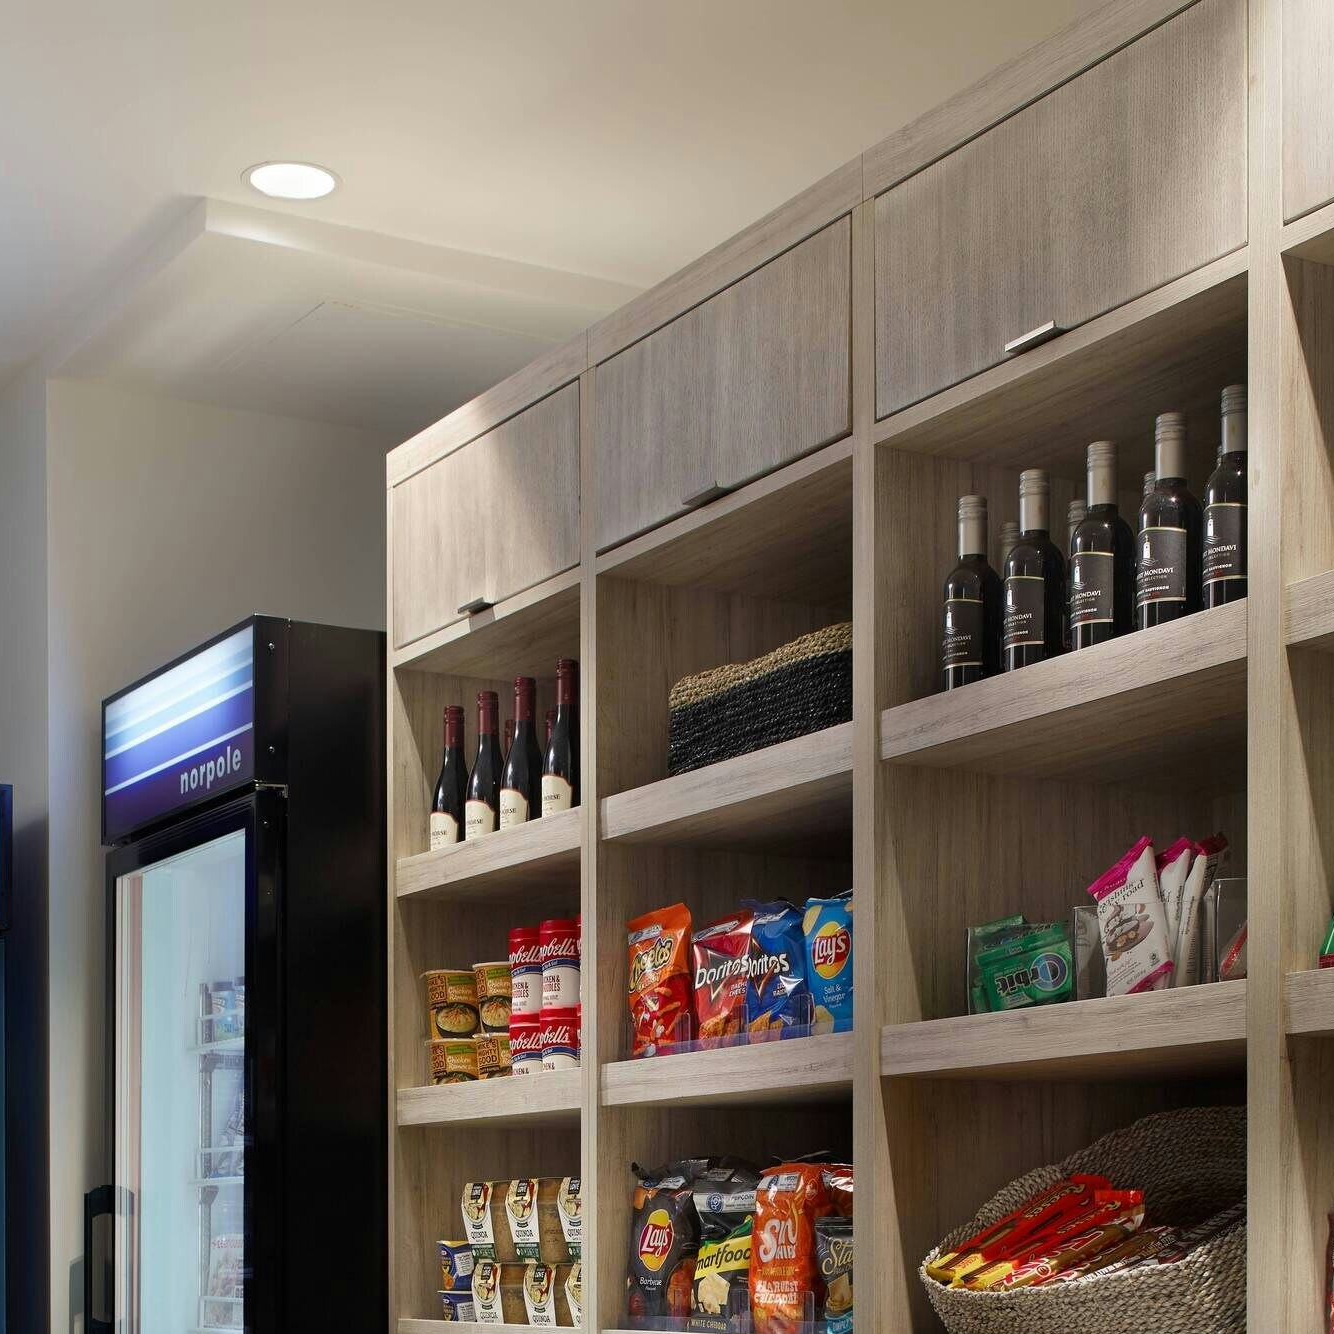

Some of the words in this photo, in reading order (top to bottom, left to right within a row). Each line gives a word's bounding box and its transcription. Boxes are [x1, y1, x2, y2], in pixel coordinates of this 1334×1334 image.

[1144, 567, 1174, 576] MONDAVI
[179, 745, 242, 795] norpole
[814, 932, 847, 965] Lay's
[695, 954, 750, 990] Doritos
[994, 952, 1068, 996] Orbit
